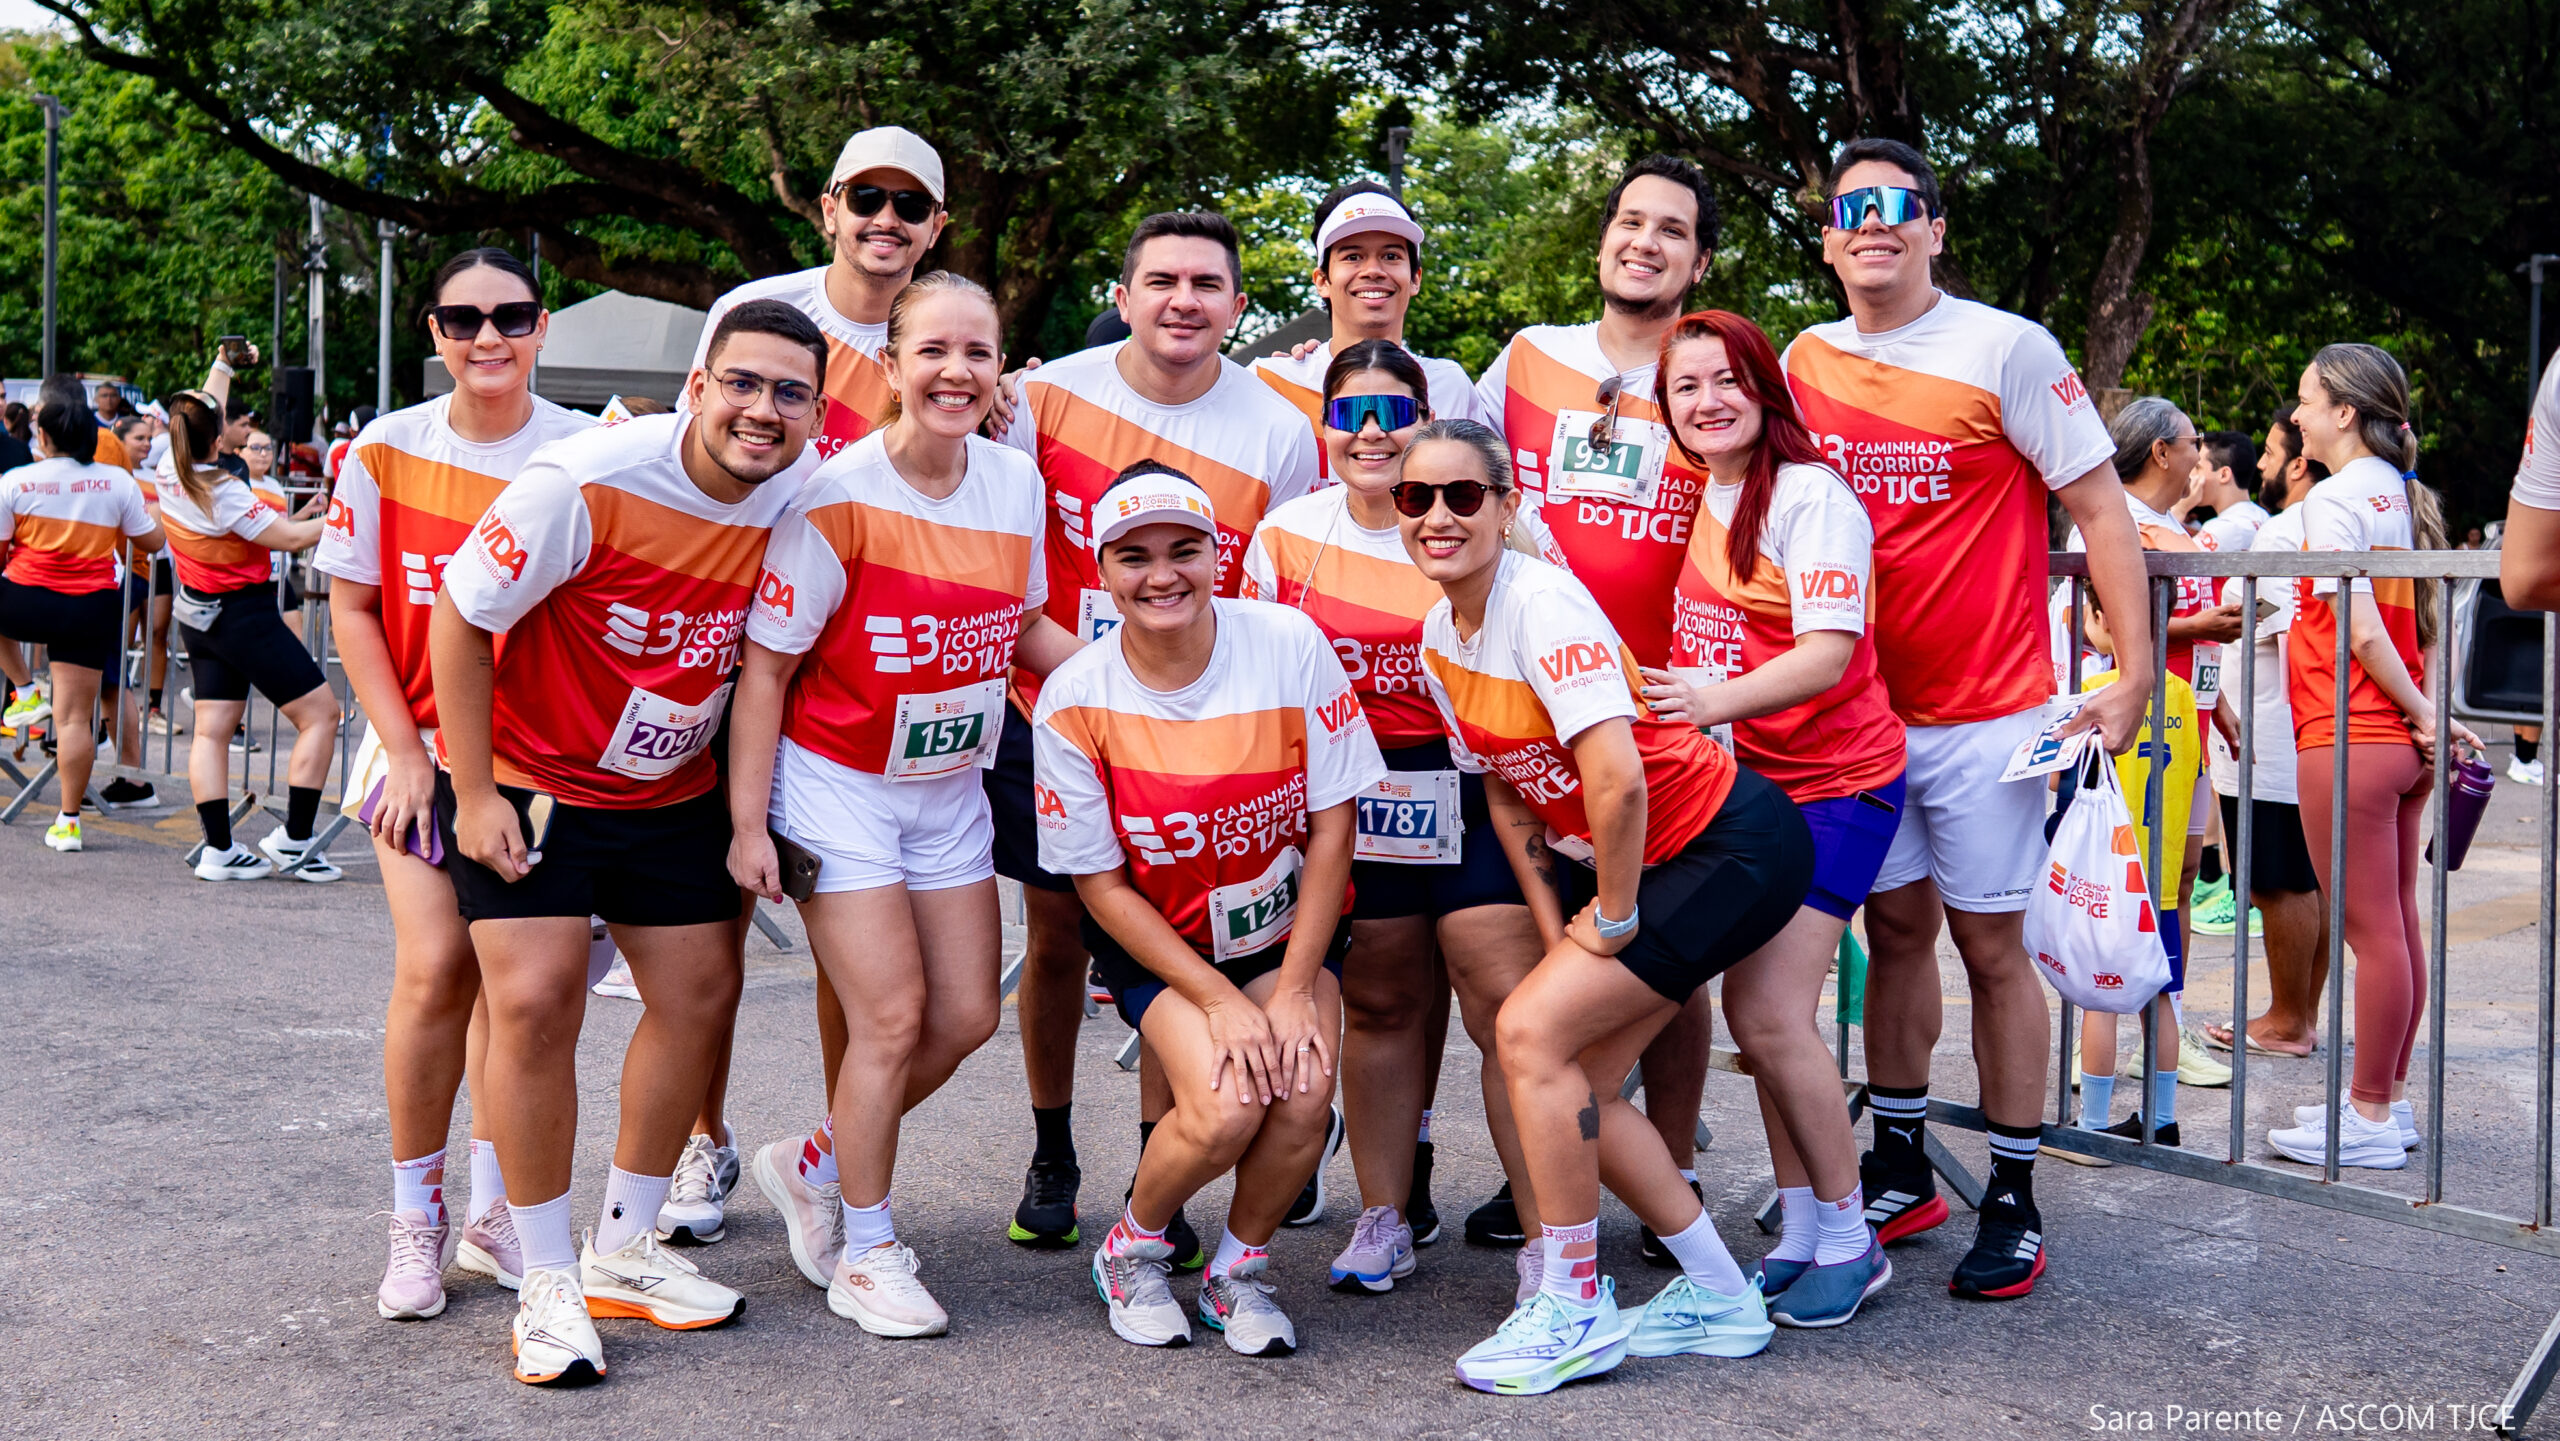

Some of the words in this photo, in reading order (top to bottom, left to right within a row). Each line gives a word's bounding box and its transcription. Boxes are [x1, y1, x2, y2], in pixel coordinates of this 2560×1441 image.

[1856, 441, 1953, 455] CAMINHADA
[1852, 456, 1952, 473] /CORRIDA
[87, 479, 111, 491] TJCE
[1853, 475, 1881, 494] DO
[1883, 474, 1951, 505] TJCE
[1578, 503, 1614, 526] DO
[1618, 509, 1690, 544] TJCE
[479, 505, 529, 582] VIDA
[1800, 569, 1861, 604] VIDA
[1684, 597, 1749, 623] CAMINHADA
[1680, 610, 1746, 641] /CORRIDA
[678, 647, 715, 668] DO
[943, 651, 973, 675] DO
[1538, 641, 1616, 683] VIDA
[1374, 675, 1409, 695] DO
[1554, 682, 1570, 695] em
[625, 702, 641, 725] 10KM
[900, 710, 909, 729] 3KM
[627, 722, 707, 758] 2091
[921, 716, 974, 755] 157
[1329, 733, 1343, 745] em
[1360, 800, 1435, 836] 1787
[1215, 836, 1250, 860] DO
[1215, 900, 1224, 917] 3KM
[1242, 882, 1290, 931] 123
[2069, 894, 2086, 907] DO
